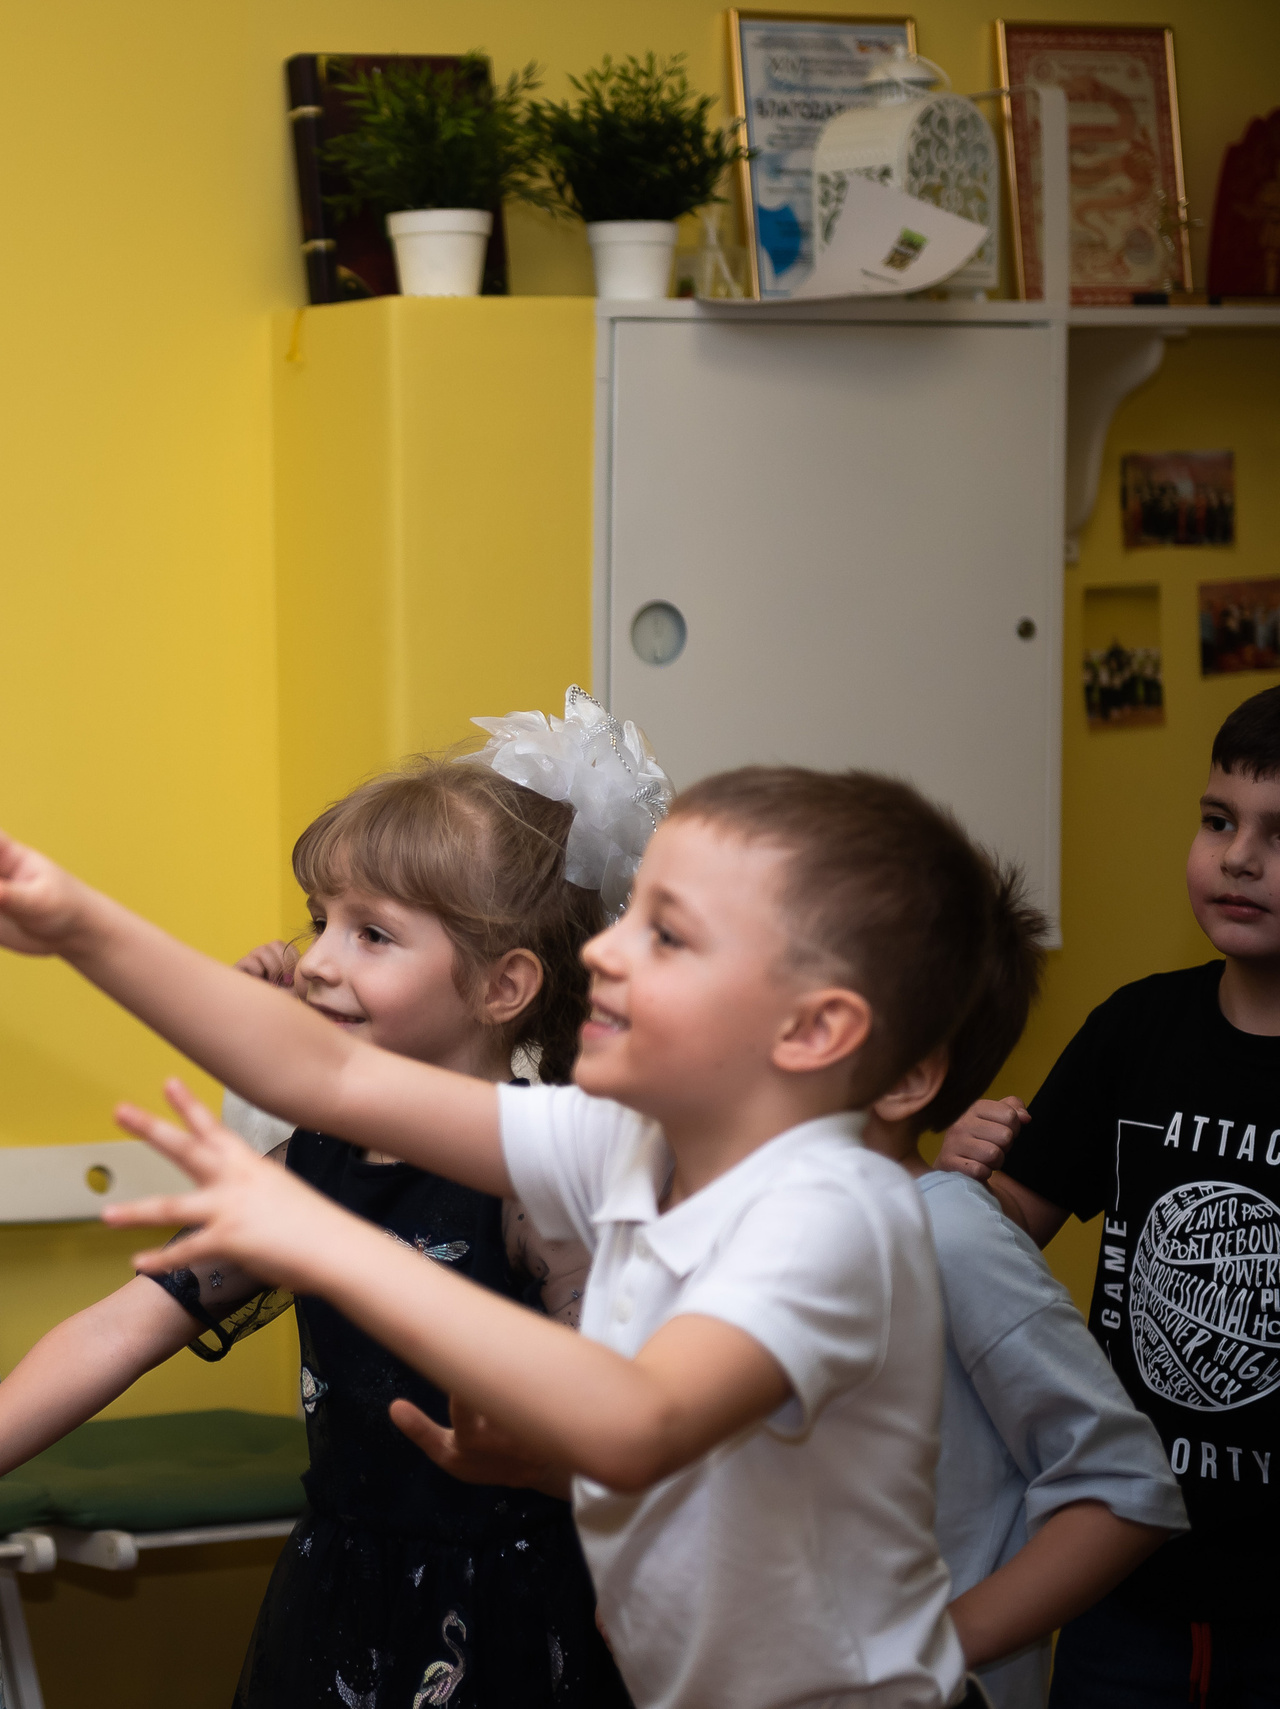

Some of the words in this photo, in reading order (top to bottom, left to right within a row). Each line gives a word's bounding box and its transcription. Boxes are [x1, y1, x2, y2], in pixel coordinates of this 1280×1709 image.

[1163, 1111, 1280, 1167] ATTAC
[1173, 1196, 1238, 1237] PLAYER
[1241, 1202, 1273, 1221] PASS
[1160, 1232, 1211, 1260] SPORT
[1101, 1216, 1127, 1330] GAME
[1213, 1258, 1280, 1288] POWER
[1148, 1261, 1255, 1338] PROFESSIONAL
[1192, 1355, 1242, 1404] LUCK
[1213, 1336, 1280, 1391] HIGH
[1171, 1437, 1271, 1484] ORTY
